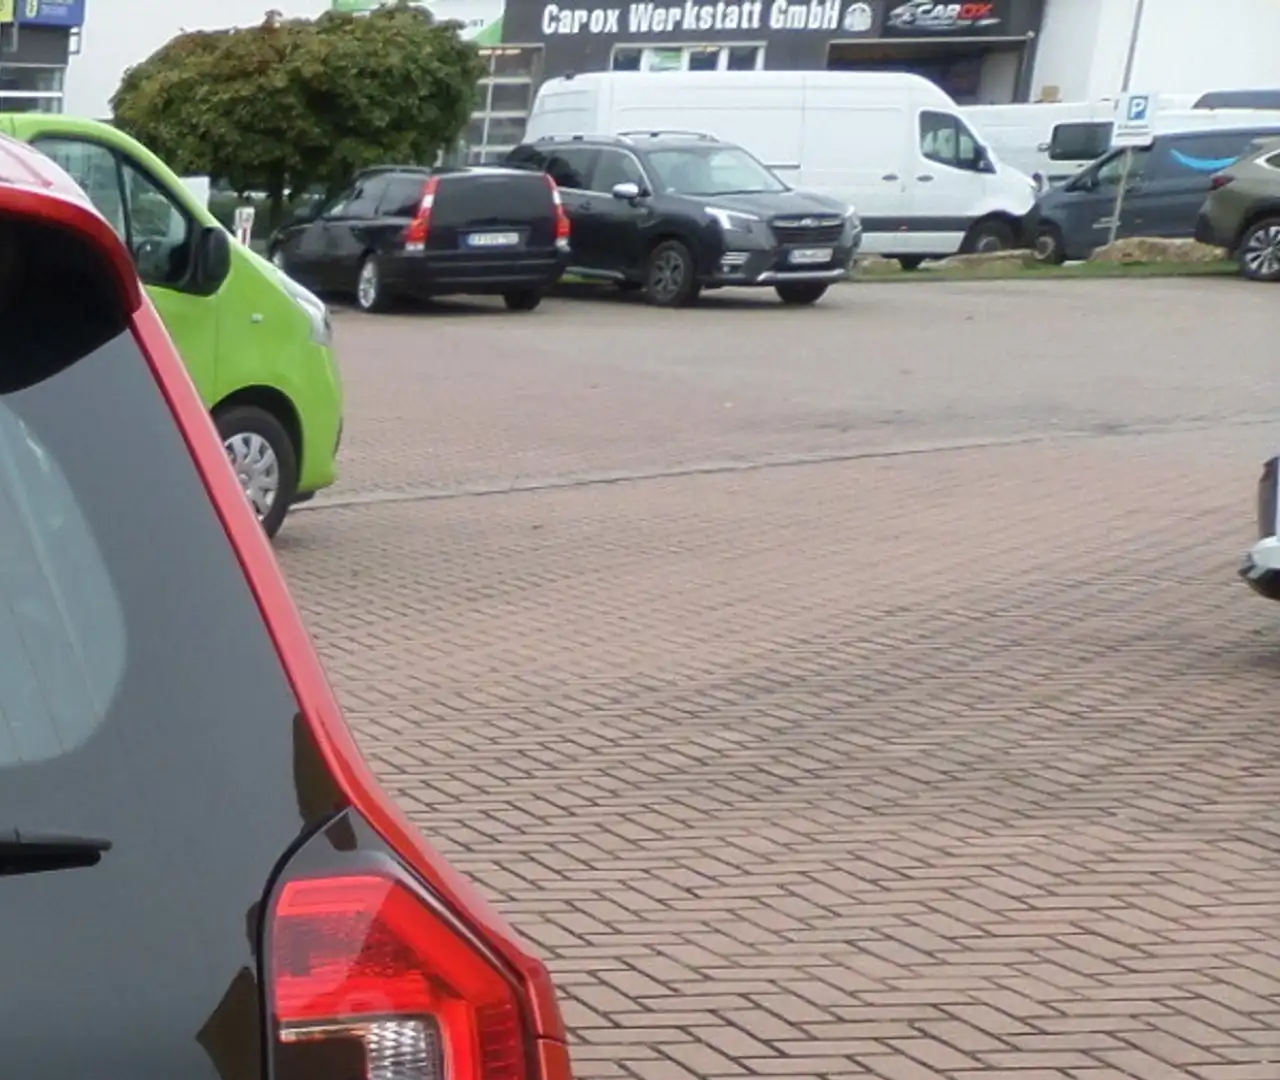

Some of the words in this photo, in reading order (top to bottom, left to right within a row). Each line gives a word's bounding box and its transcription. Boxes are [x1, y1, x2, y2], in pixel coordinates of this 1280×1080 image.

[541, 4, 622, 35] Carox
[628, 2, 762, 32] Werkstatt
[768, 1, 841, 29] GmbH
[915, 4, 993, 20] CAROX
